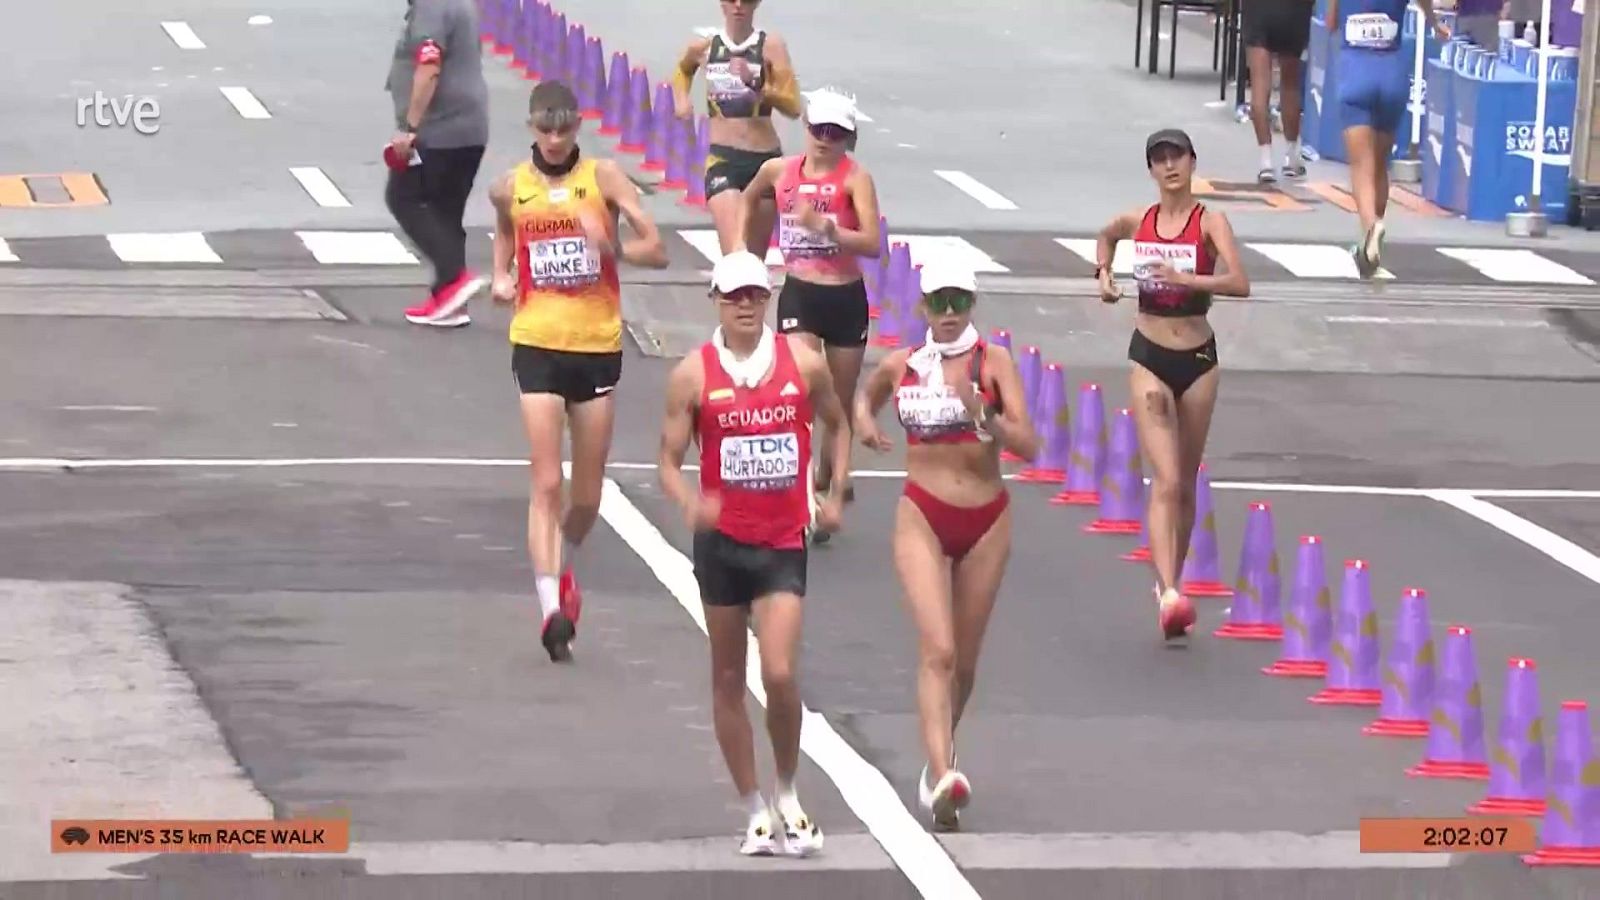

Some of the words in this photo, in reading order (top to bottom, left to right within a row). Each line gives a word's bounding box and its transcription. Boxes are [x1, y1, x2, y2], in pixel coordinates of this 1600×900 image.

[1505, 138, 1569, 151] SWAT
[534, 258, 583, 276] LINKE
[717, 404, 797, 429] ECUADOR
[742, 436, 795, 456] TDK
[723, 457, 785, 477] HURTADO
